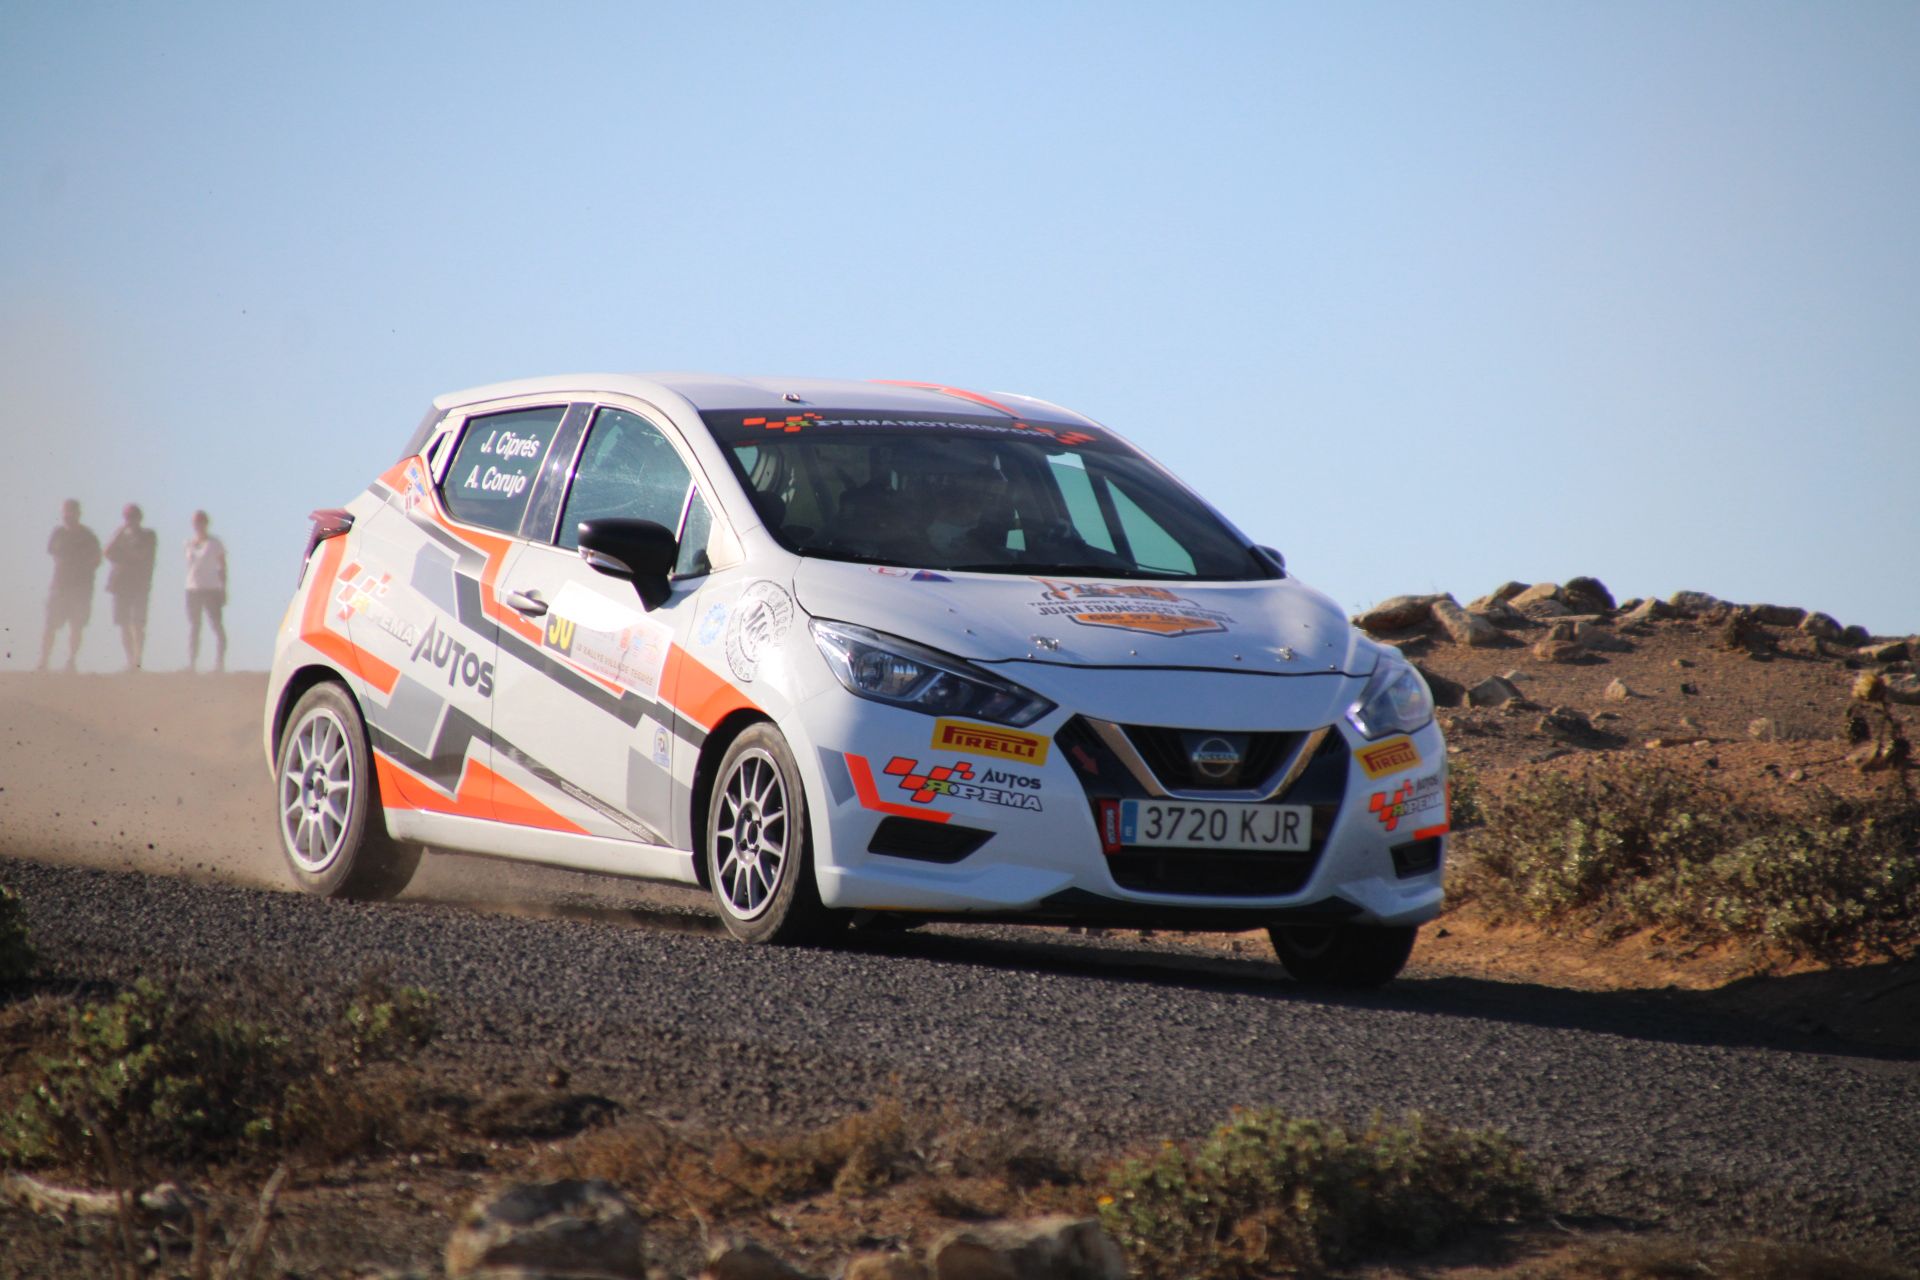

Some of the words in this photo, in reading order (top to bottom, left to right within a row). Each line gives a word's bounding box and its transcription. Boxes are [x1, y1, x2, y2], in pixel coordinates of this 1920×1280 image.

[481, 430, 497, 453] J.
[496, 431, 540, 461] Ciprés
[464, 464, 480, 489] A.
[482, 466, 527, 498] Corujo
[1040, 605, 1083, 616] JUAN
[410, 615, 494, 698] AUTOS
[942, 725, 1039, 758] PIRELLI
[1363, 741, 1417, 773] PIRELLI
[980, 767, 1042, 790] AUTOS
[1144, 806, 1228, 842] 3720
[1240, 810, 1301, 845] KJR
